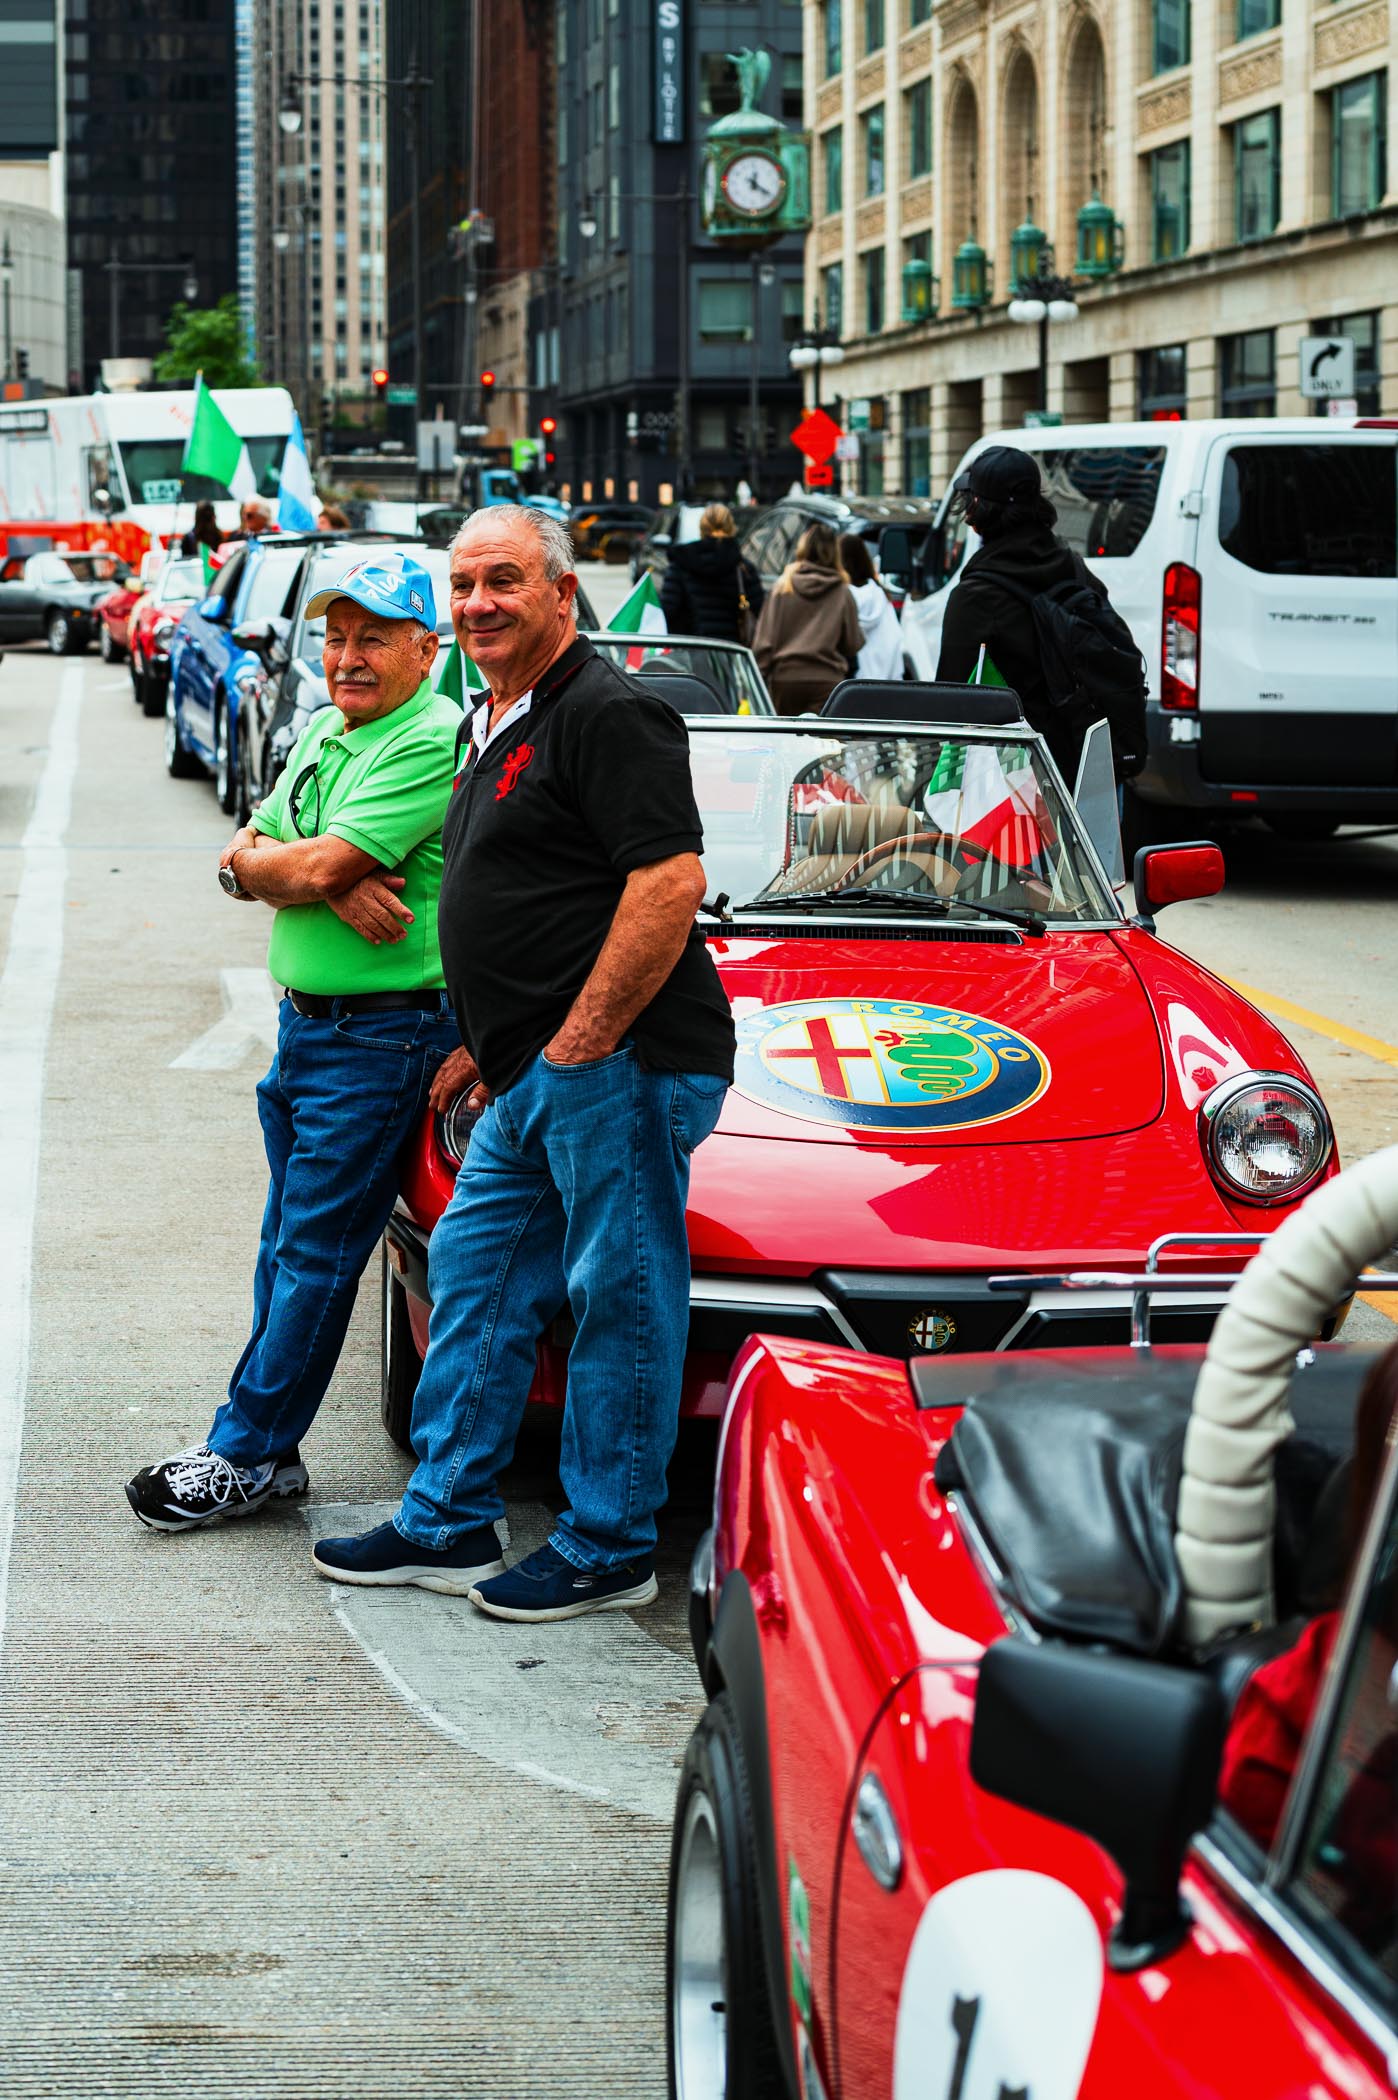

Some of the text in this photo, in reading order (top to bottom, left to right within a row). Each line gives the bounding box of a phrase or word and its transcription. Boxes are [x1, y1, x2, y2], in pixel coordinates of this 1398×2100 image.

[1311, 377, 1342, 391] ONLY
[1268, 612, 1351, 623] TRANSIT
[735, 1001, 1032, 1063] ALFA ROMEO
